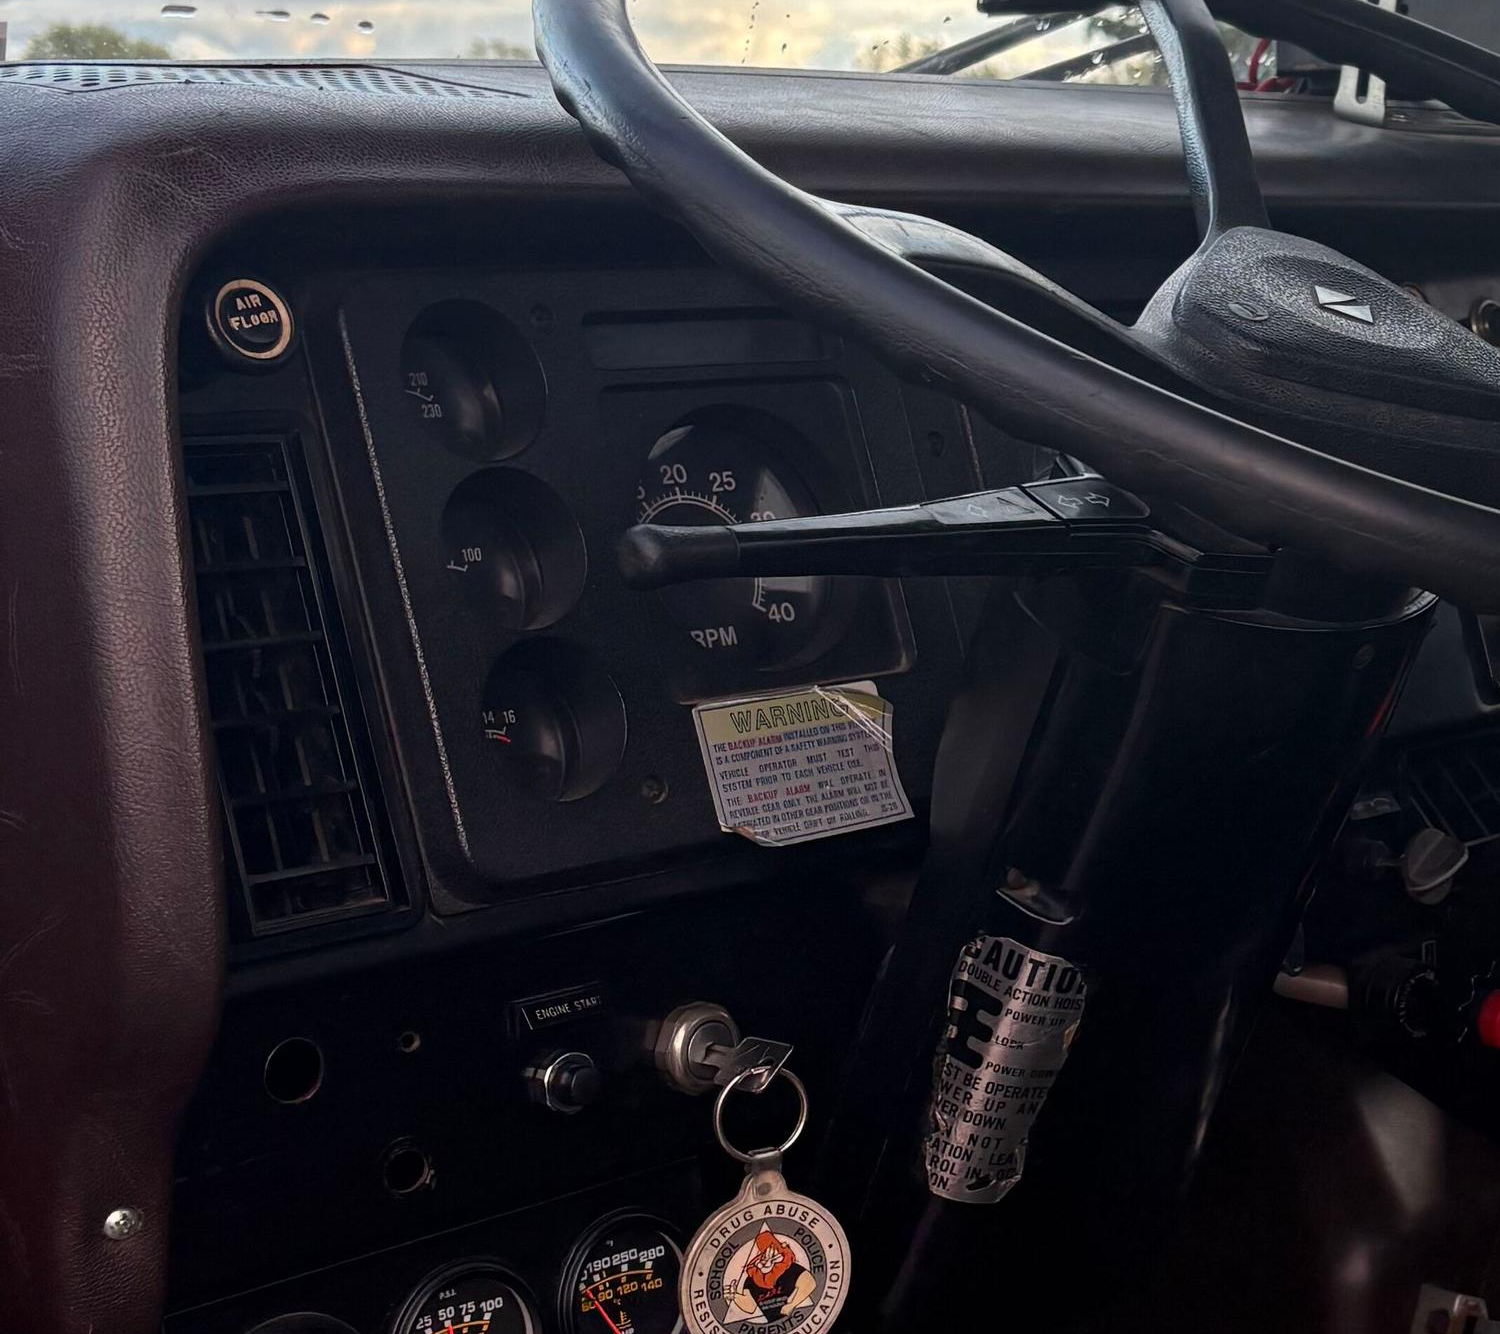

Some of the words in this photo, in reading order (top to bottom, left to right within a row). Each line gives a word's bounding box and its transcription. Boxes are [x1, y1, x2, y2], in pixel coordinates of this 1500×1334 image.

[235, 294, 262, 311] AIR
[229, 309, 279, 331] FLOOR
[408, 372, 428, 387] 210
[421, 403, 442, 418] 230
[660, 463, 687, 484] 20
[709, 471, 736, 492] 25
[461, 547, 482, 563] 100
[768, 602, 796, 623] 40
[482, 710, 495, 725] 14
[503, 709, 516, 724] 16
[730, 698, 850, 734] WARNING
[713, 743, 727, 753] THE
[719, 768, 749, 781] VEHICLE
[806, 752, 827, 764] MUST
[722, 779, 752, 793] SYSTEM
[756, 774, 778, 786] PRIOR
[748, 790, 778, 804] BACKUP
[958, 960, 1001, 992] DOUBLE
[1004, 984, 1051, 1008] ACTION
[535, 1003, 571, 1020] ENGINE
[573, 994, 601, 1011] START
[1004, 1008, 1049, 1027] POWER
[985, 1061, 1026, 1078] POWER
[963, 1072, 982, 1091] BE
[984, 1081, 1047, 1100] OPERATE
[984, 1098, 1006, 1113] UP
[930, 1138, 973, 1163] ATION
[967, 1133, 1003, 1150] NOT
[930, 1155, 957, 1176] ROL
[710, 1210, 754, 1249] DRUG
[763, 1204, 820, 1229] ABUSE
[611, 1248, 638, 1266] 250
[638, 1245, 665, 1263] 280
[794, 1227, 824, 1274] POLICE
[709, 1241, 740, 1301] SCHOOL
[415, 1315, 433, 1331] 25
[437, 1305, 456, 1322] 50
[459, 1300, 477, 1315] 75
[479, 1296, 504, 1313] 100
